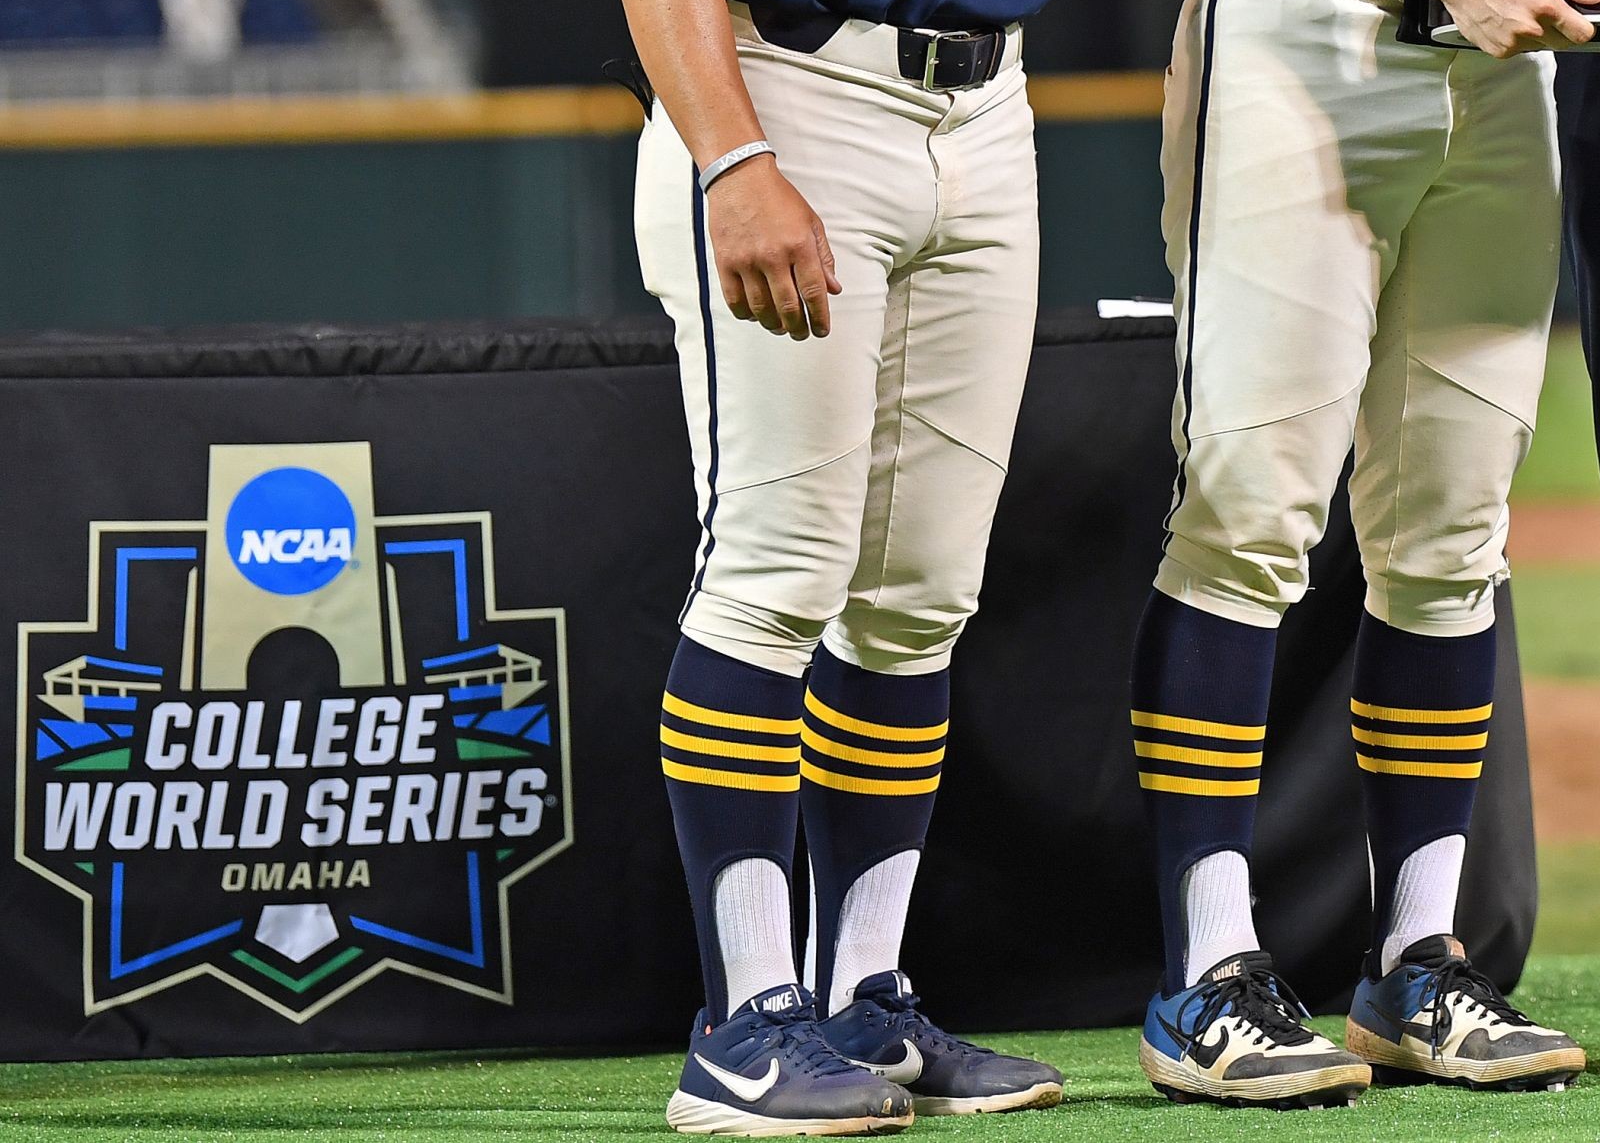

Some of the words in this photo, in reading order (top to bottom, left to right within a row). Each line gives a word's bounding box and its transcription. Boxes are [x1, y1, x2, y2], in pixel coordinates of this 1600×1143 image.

[238, 527, 352, 564] NCAA
[144, 694, 445, 771] COLLEGE
[43, 780, 289, 851] WORLD
[299, 767, 549, 848] SERIES
[221, 859, 371, 891] OMAHA
[1212, 961, 1242, 981] NIKE
[762, 990, 793, 1013] NIKE
